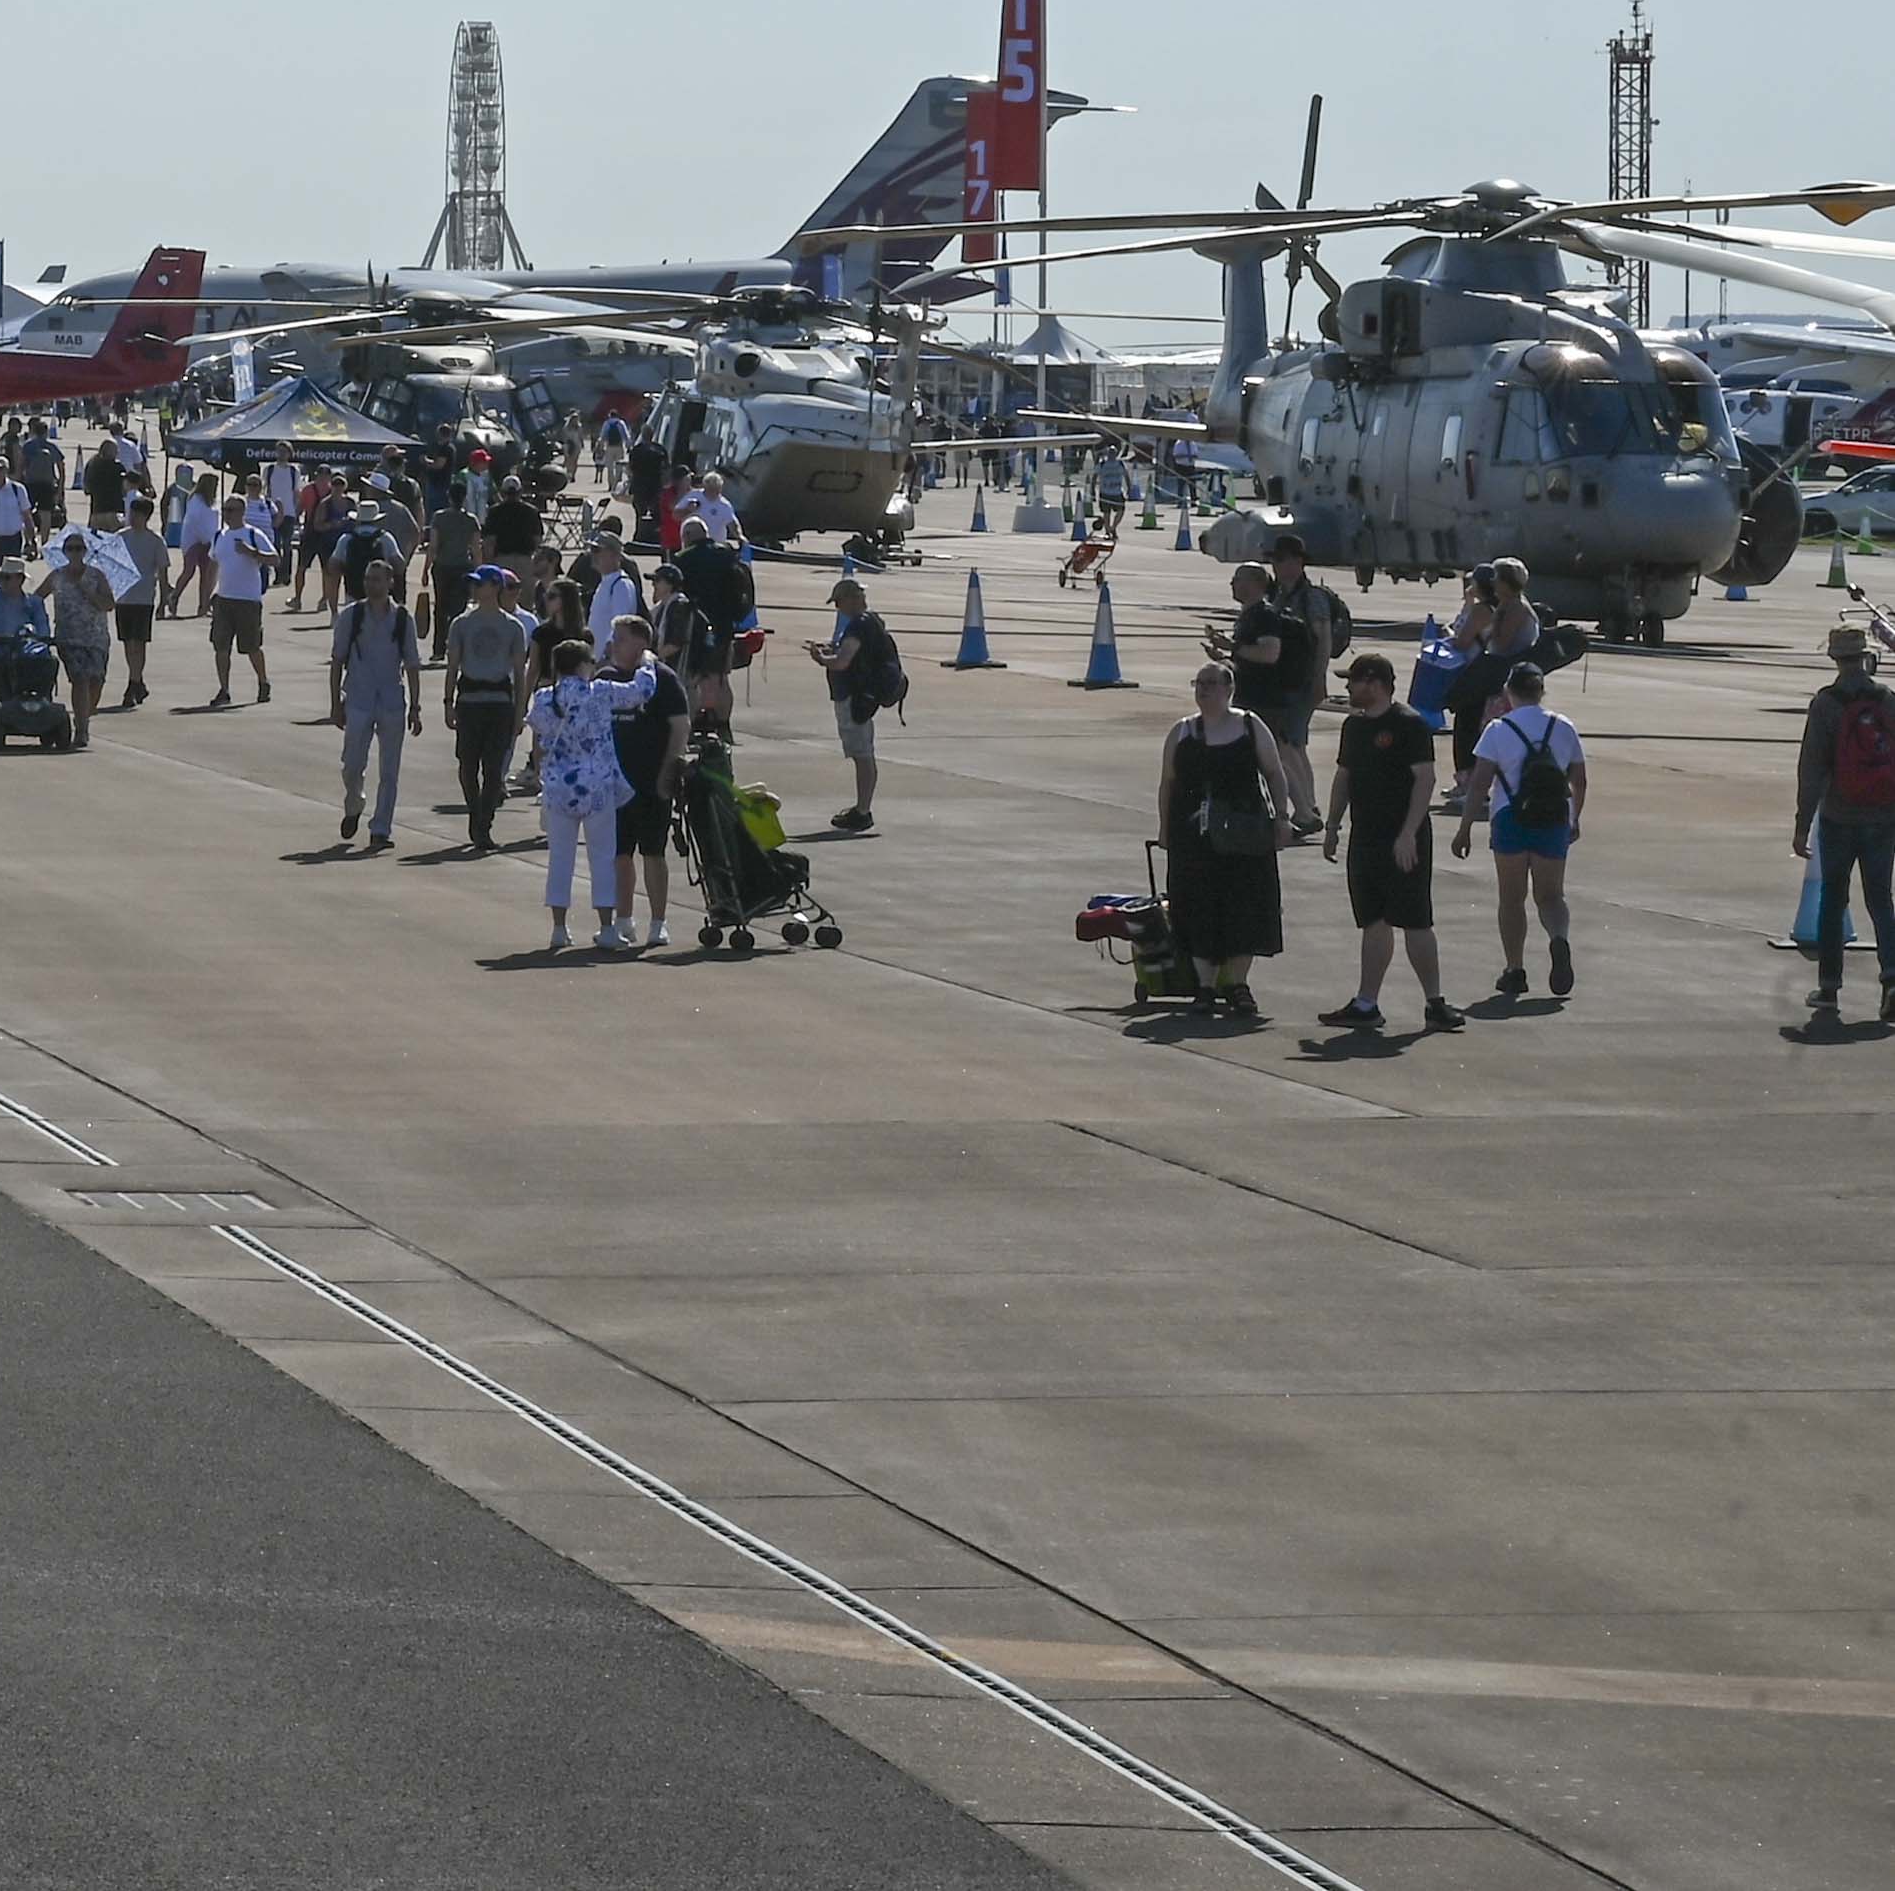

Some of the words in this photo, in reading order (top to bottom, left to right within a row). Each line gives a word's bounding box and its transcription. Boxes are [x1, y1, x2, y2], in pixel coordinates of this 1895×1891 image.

[966, 140, 990, 215] 17
[54, 334, 83, 345] MAB
[246, 448, 279, 459] Defen
[292, 447, 348, 461] Helicopter
